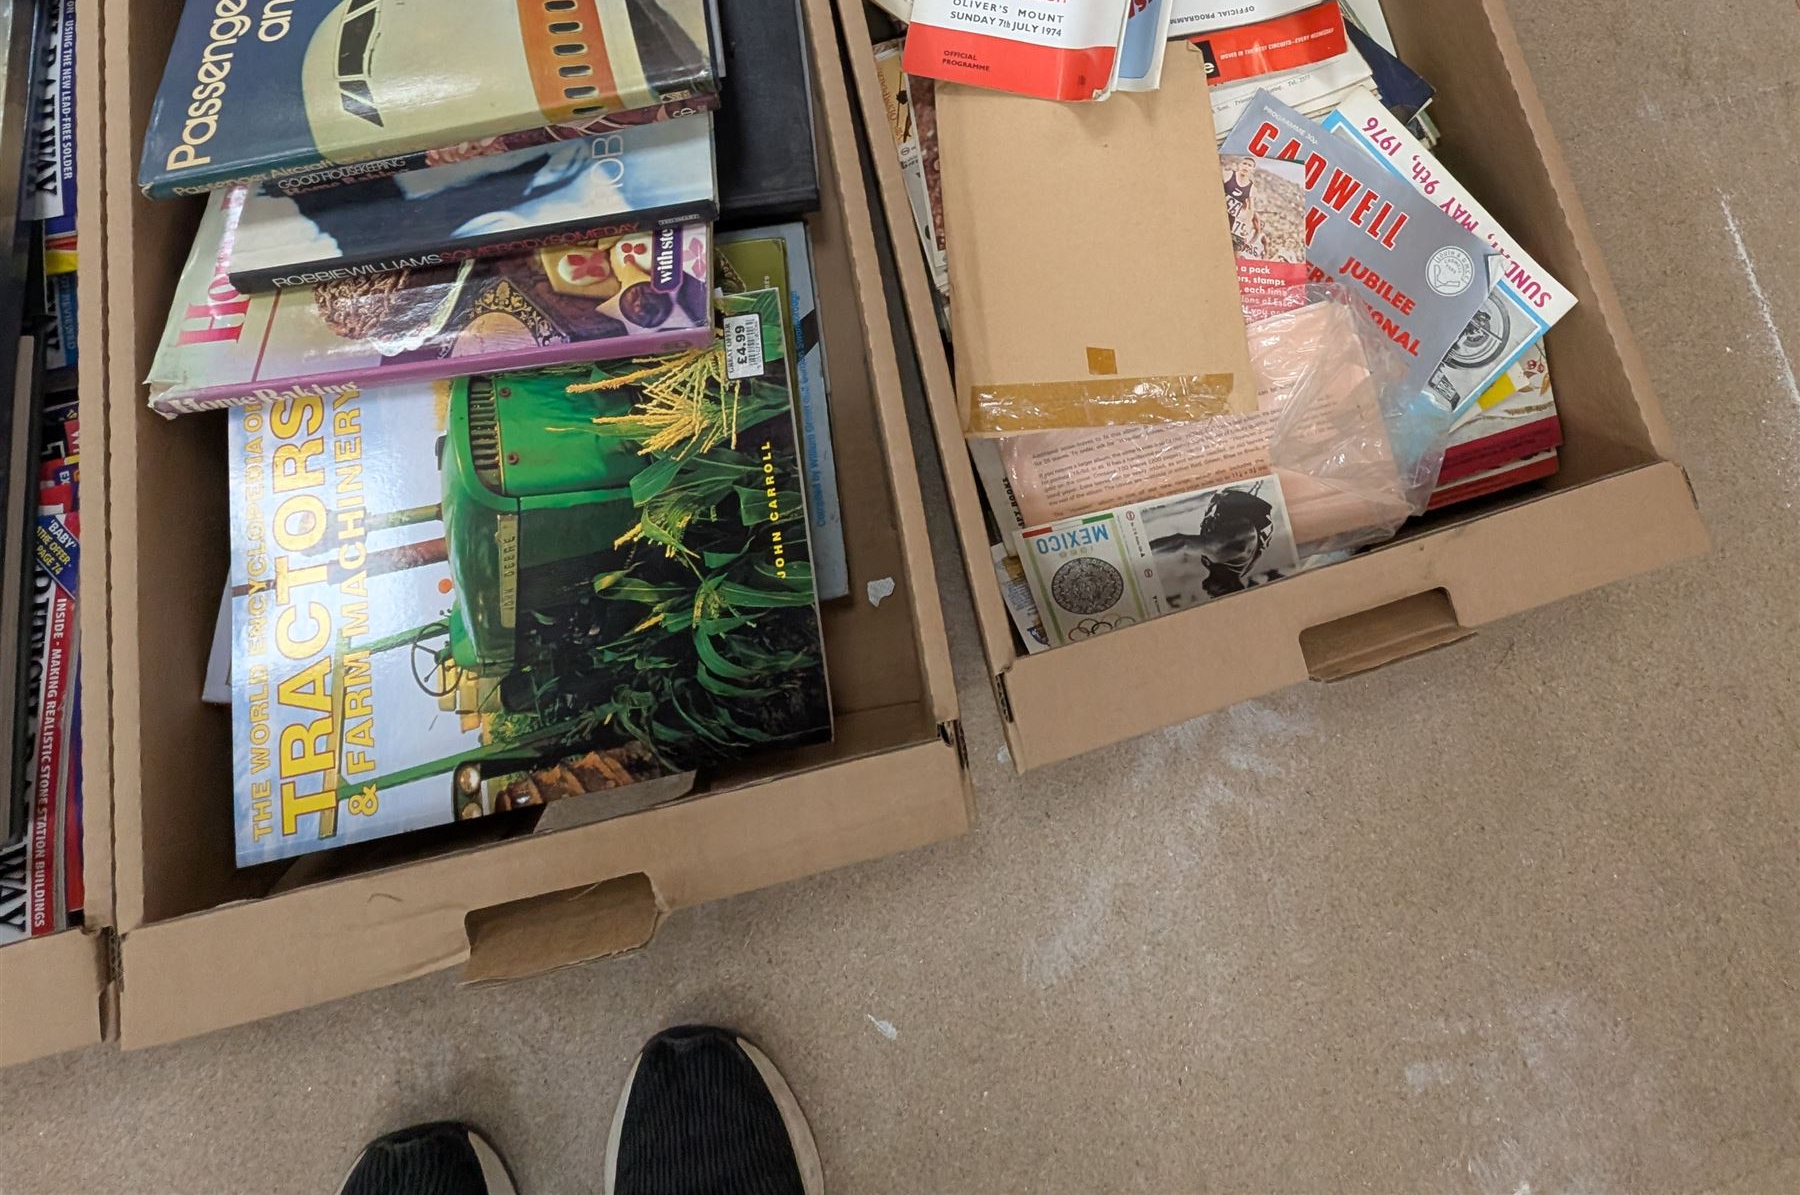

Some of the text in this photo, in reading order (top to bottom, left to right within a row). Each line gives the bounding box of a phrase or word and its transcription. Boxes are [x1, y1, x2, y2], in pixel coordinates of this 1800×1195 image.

[65, 0, 74, 14] ON
[1019, 7, 1065, 24] MOUNT
[1223, 5, 1255, 19] OFFICIAL
[62, 20, 73, 47] USING
[949, 10, 1063, 39] SUNDAY 7th JULY 1974
[62, 48, 72, 66] THE
[941, 57, 991, 74] PROGRAMME
[943, 49, 979, 62] OFFICIAL
[61, 68, 72, 89] NEW
[60, 90, 72, 141] LEAD-FREE
[1263, 104, 1306, 136] PROGRAMME
[60, 142, 74, 180] SOLDER
[172, 174, 266, 197] Passenger
[1245, 120, 1411, 251] CADWELL
[1361, 116, 1479, 241] 1976 9th, MAY
[658, 250, 673, 285] with
[1249, 266, 1271, 275] pack
[1253, 277, 1286, 286] stamps
[1244, 286, 1266, 295] each
[1339, 254, 1417, 316] JUBILEE
[735, 326, 747, 364] £4.99
[256, 381, 360, 404] Baking
[812, 483, 826, 527] Compiled
[1001, 477, 1017, 507] BOOKS
[761, 439, 788, 581] JOHN CARROLL
[49, 520, 77, 548] 'BABY'
[1036, 523, 1111, 556] MEXICO
[38, 547, 63, 575] PAGE 74
[49, 543, 70, 564] OFFER
[269, 395, 338, 837] TRACTORS
[332, 389, 379, 817] & FARM MACHINERY
[244, 434, 271, 840] THE WORLD ENCYCLOPEDIA
[33, 598, 67, 927] INSIDE MAKING REALISTIC STONE STATION BUILDINGS
